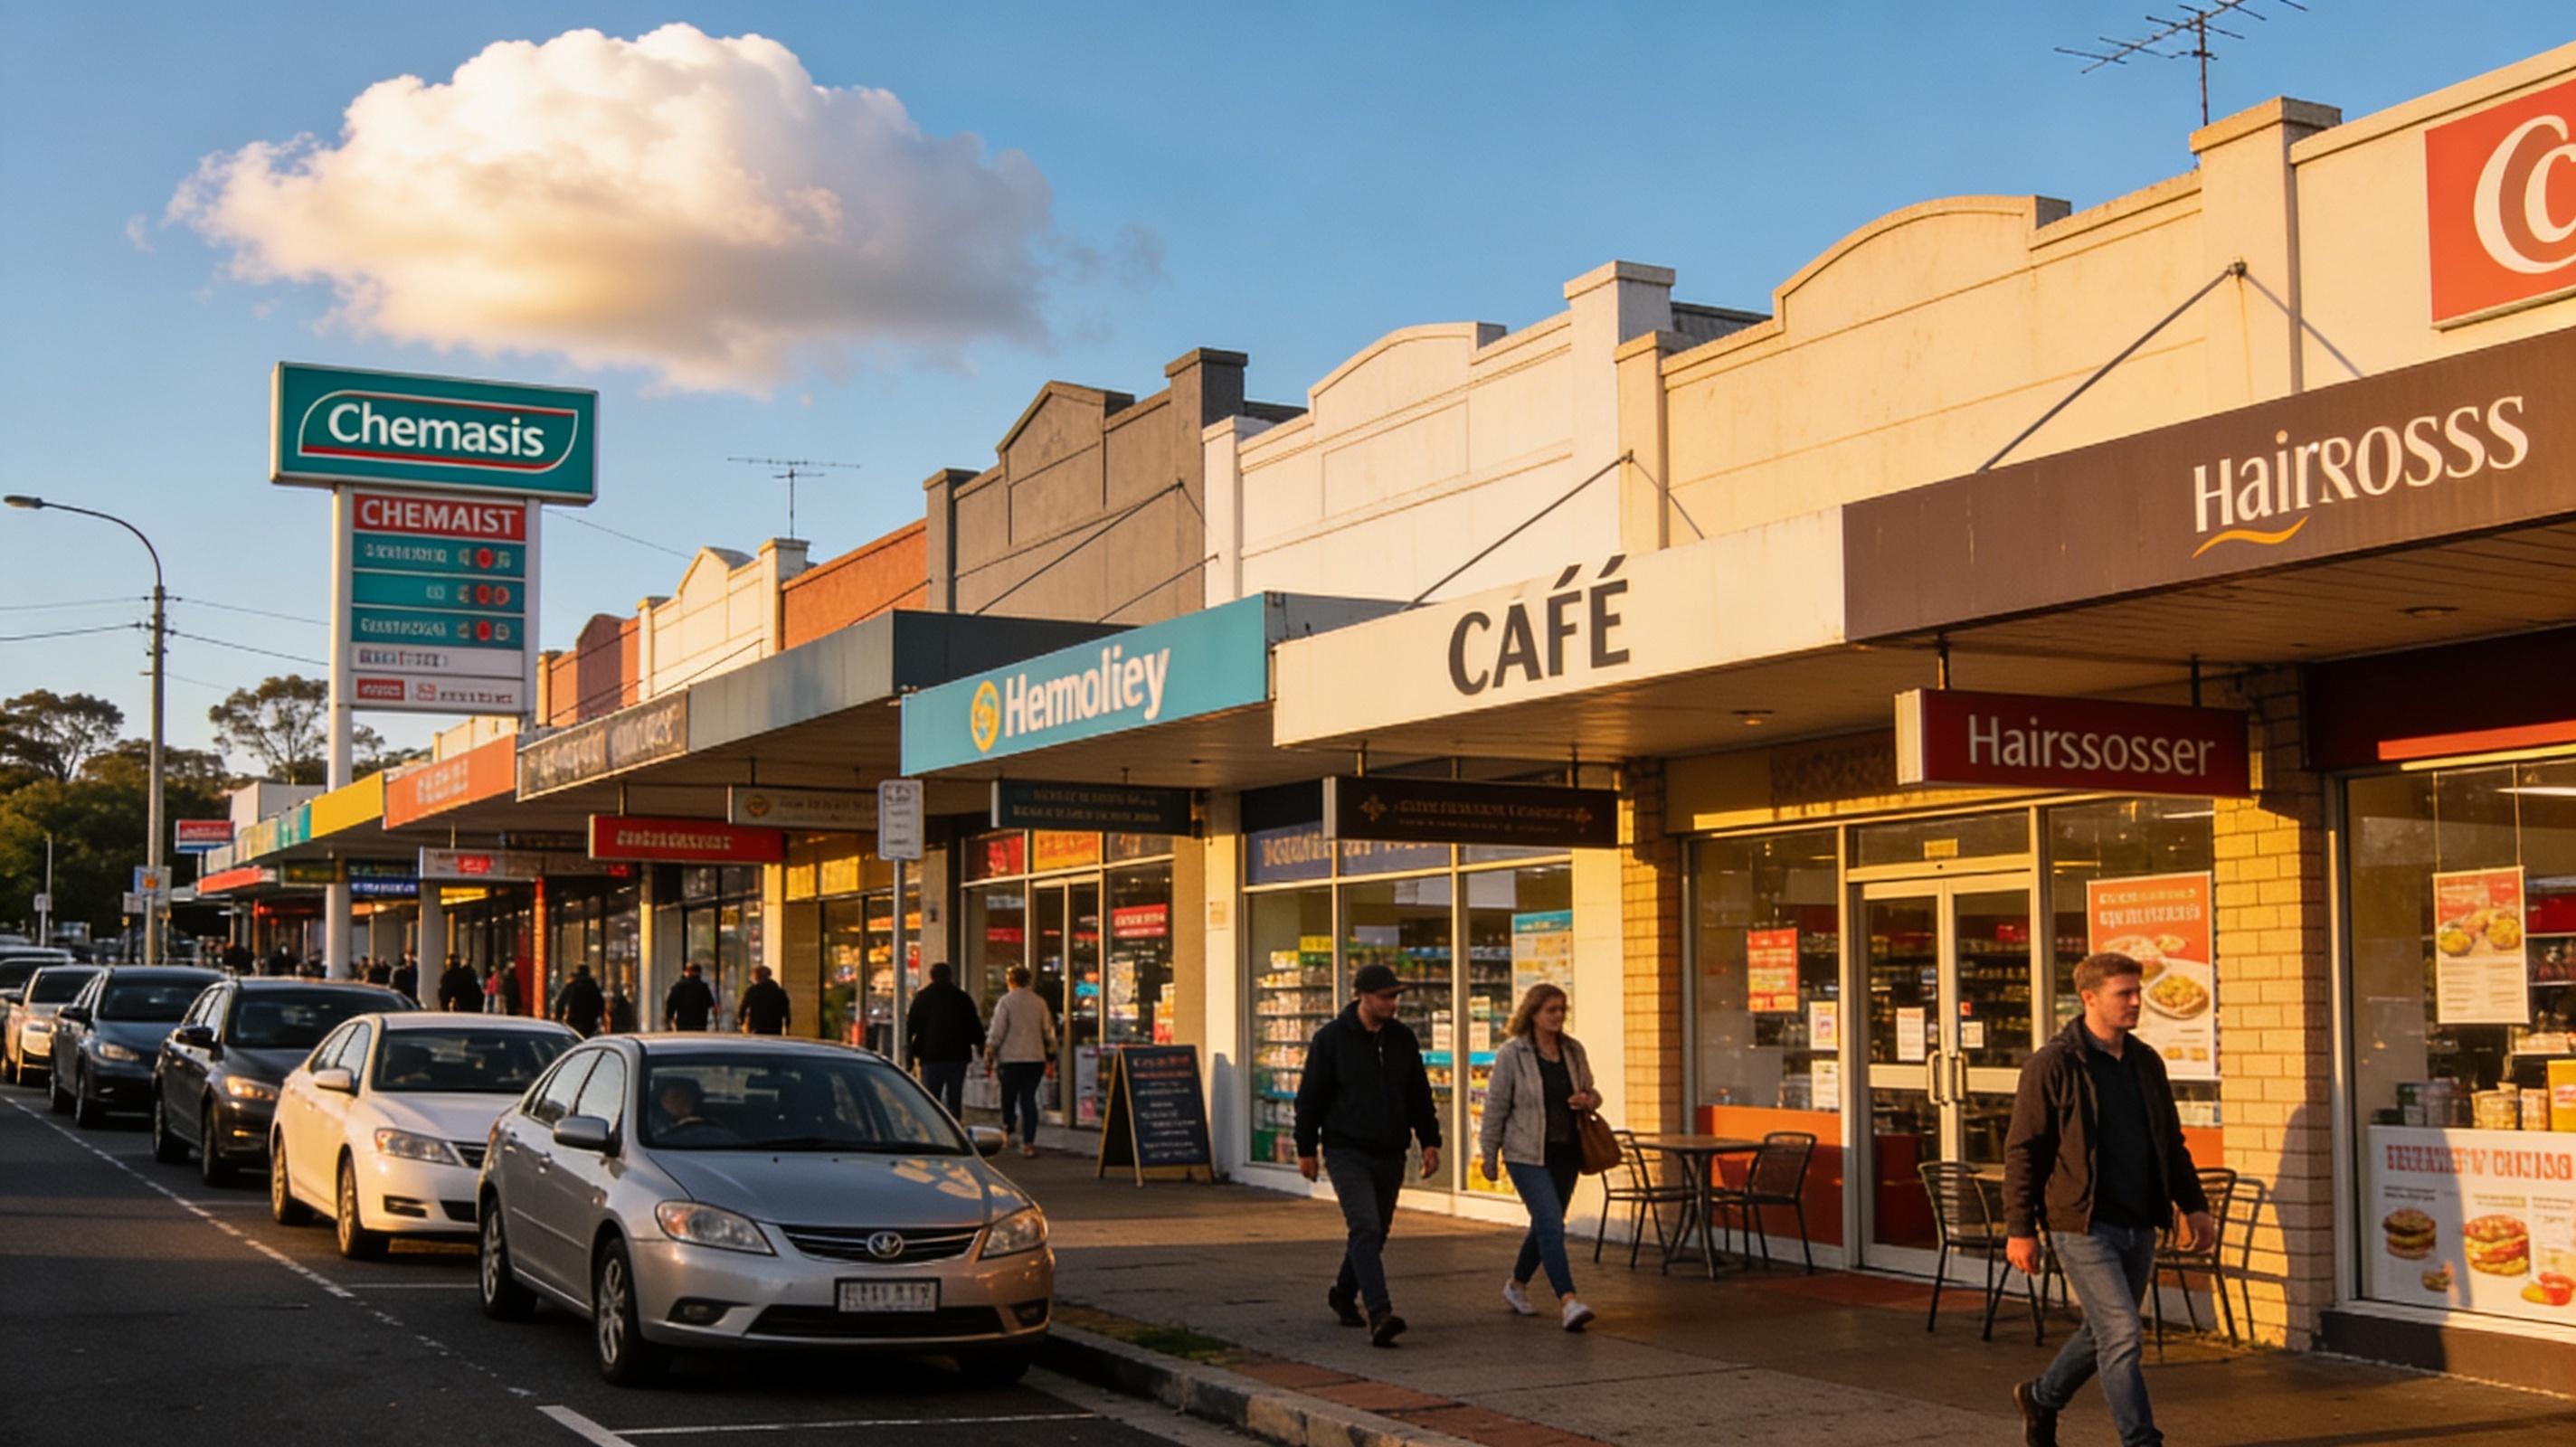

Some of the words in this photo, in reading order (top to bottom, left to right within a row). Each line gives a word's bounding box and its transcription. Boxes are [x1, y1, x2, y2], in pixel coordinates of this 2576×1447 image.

[328, 402, 545, 457] Chemasis
[362, 500, 516, 534] CHEMAIST
[1968, 714, 2214, 775] Hairssosser
